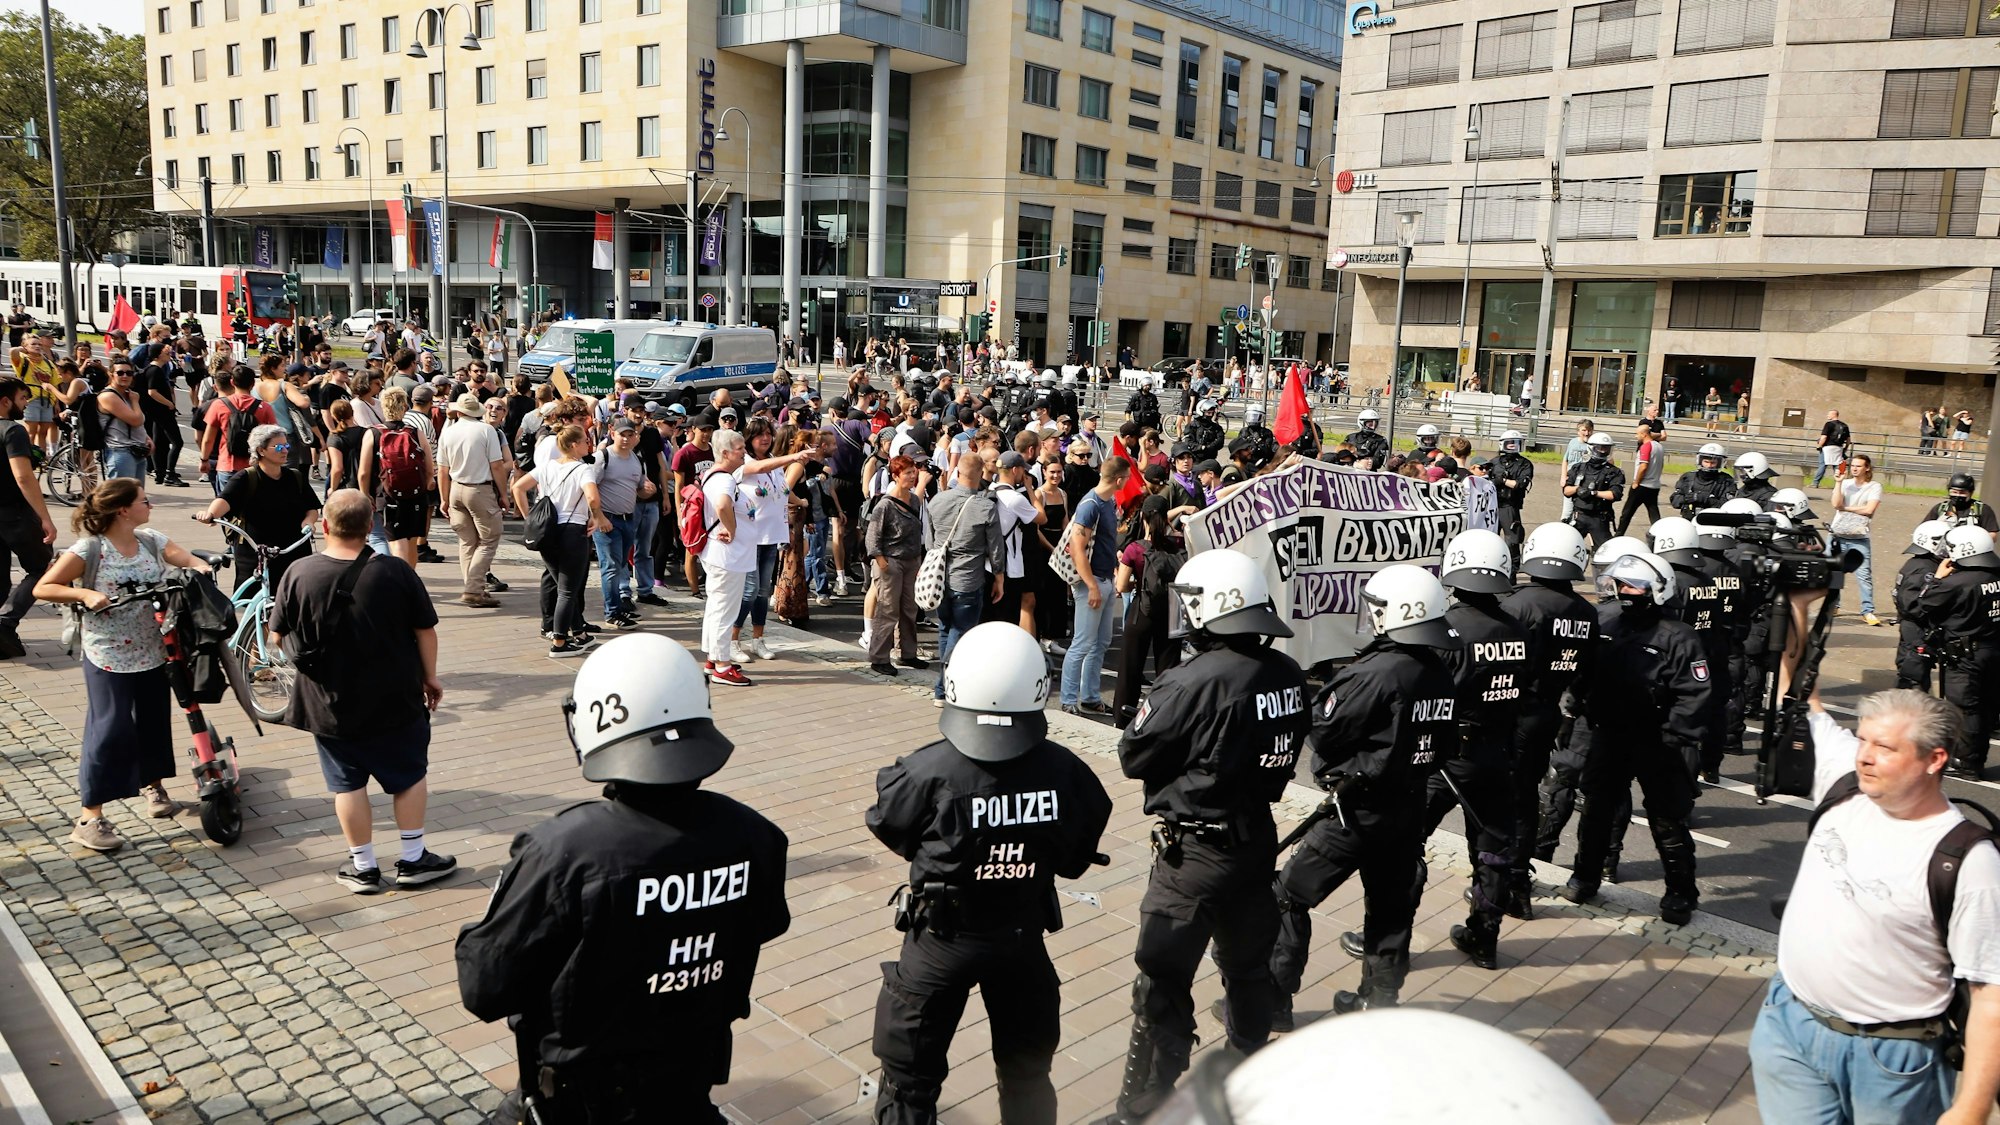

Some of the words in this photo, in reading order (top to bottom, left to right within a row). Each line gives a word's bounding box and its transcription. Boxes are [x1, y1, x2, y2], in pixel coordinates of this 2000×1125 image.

[697, 58, 715, 174] Dorint
[1352, 173, 1377, 189] JLL
[1347, 250, 1413, 264] INFOMOTI
[940, 283, 971, 296] BISTROT
[889, 306, 918, 314] Heumarkt
[623, 365, 664, 374] POLIZEI
[724, 365, 748, 376] POLIZEI
[1325, 470, 1395, 511] FUNDIS
[1659, 537, 1676, 550] 23
[1960, 541, 1975, 553] 23
[1450, 550, 1467, 567] 23
[1214, 588, 1246, 614] 23
[1400, 601, 1428, 621] 23
[1552, 617, 1591, 639] POLIZEI
[1474, 641, 1526, 662] POLIZEI
[1491, 674, 1514, 689] HH
[590, 693, 630, 734] 23
[1412, 698, 1455, 723] POLIZEI
[972, 790, 1059, 829] POLIZEI
[988, 843, 1025, 863] HH
[973, 863, 1036, 881] 123301
[636, 861, 751, 917] POLIZEI
[668, 932, 716, 966] HH
[646, 960, 724, 995] 123118
